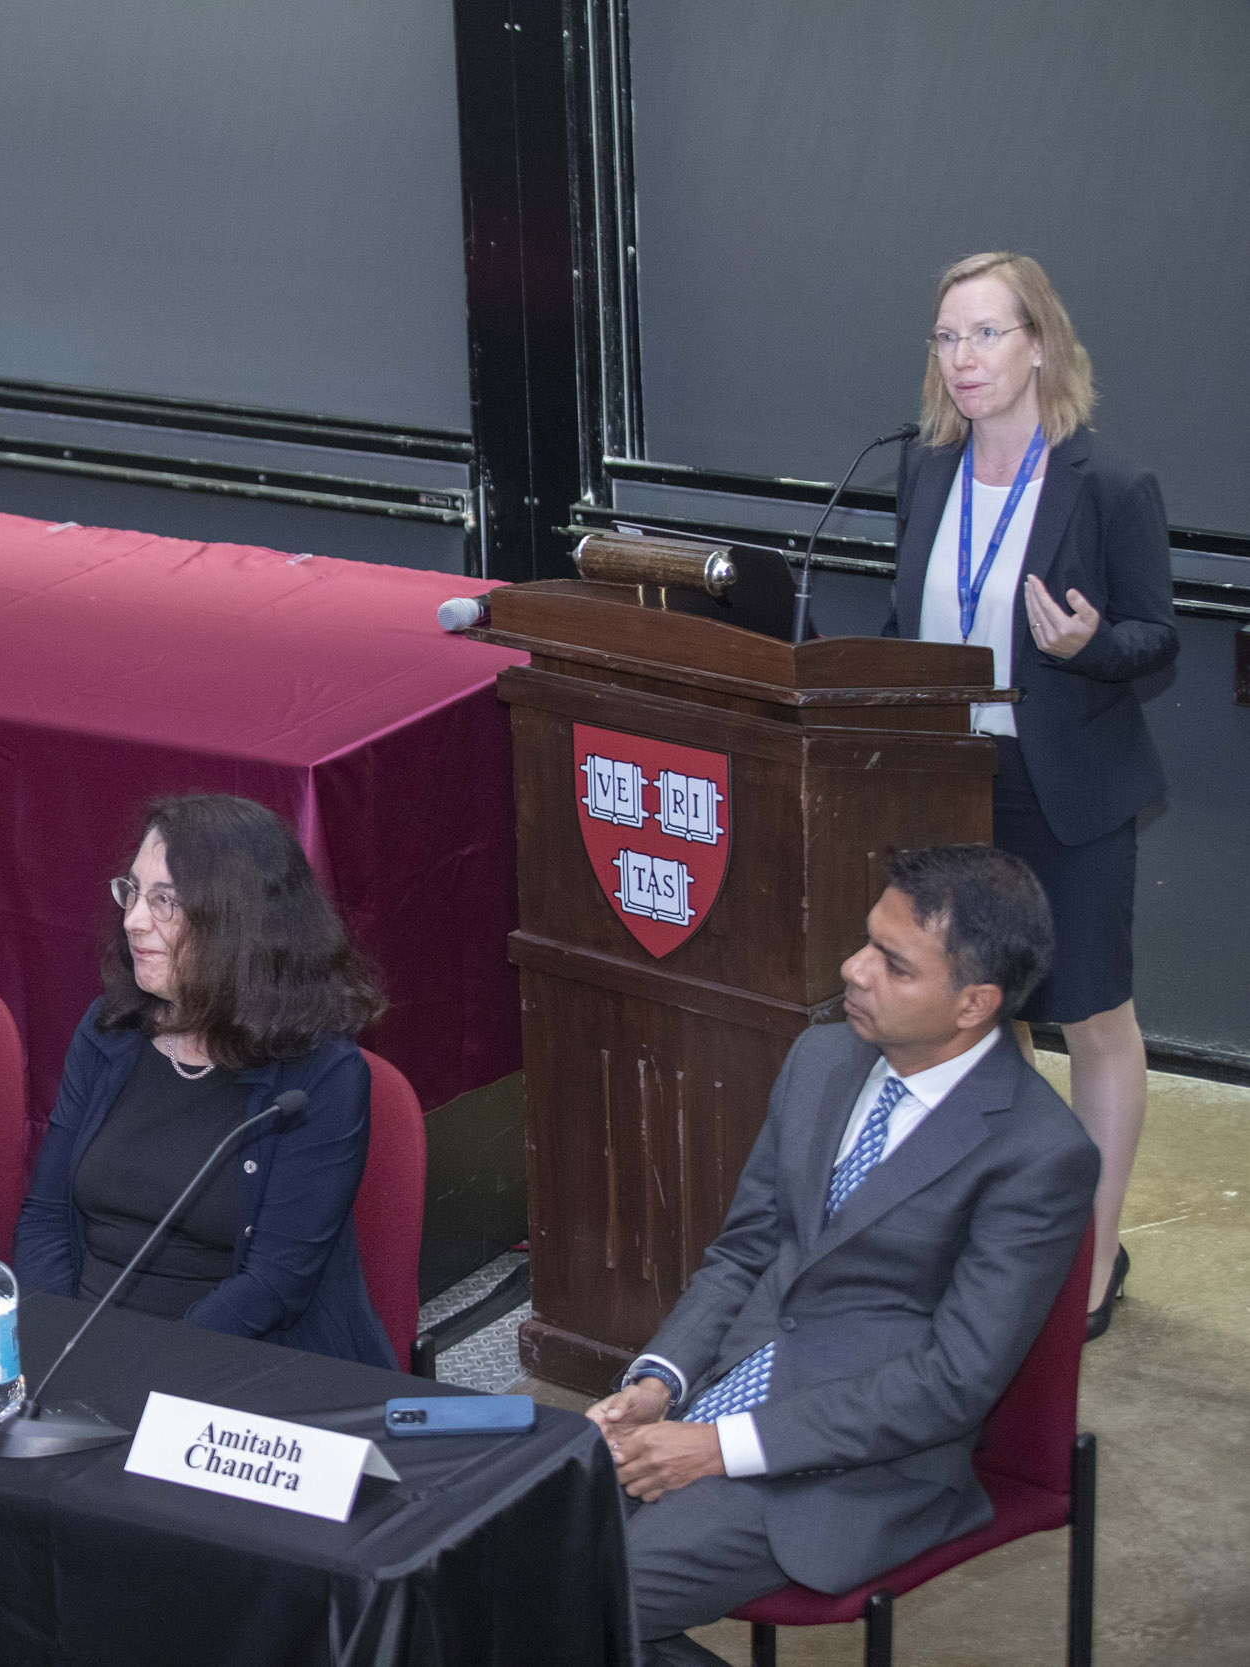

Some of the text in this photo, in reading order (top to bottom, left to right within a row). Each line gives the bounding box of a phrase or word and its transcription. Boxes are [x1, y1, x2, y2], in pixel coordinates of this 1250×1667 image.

[596, 772, 700, 819] VE RI
[632, 865, 675, 899] TAS
[196, 1422, 303, 1464] Amitabh
[184, 1443, 301, 1492] Chandra
